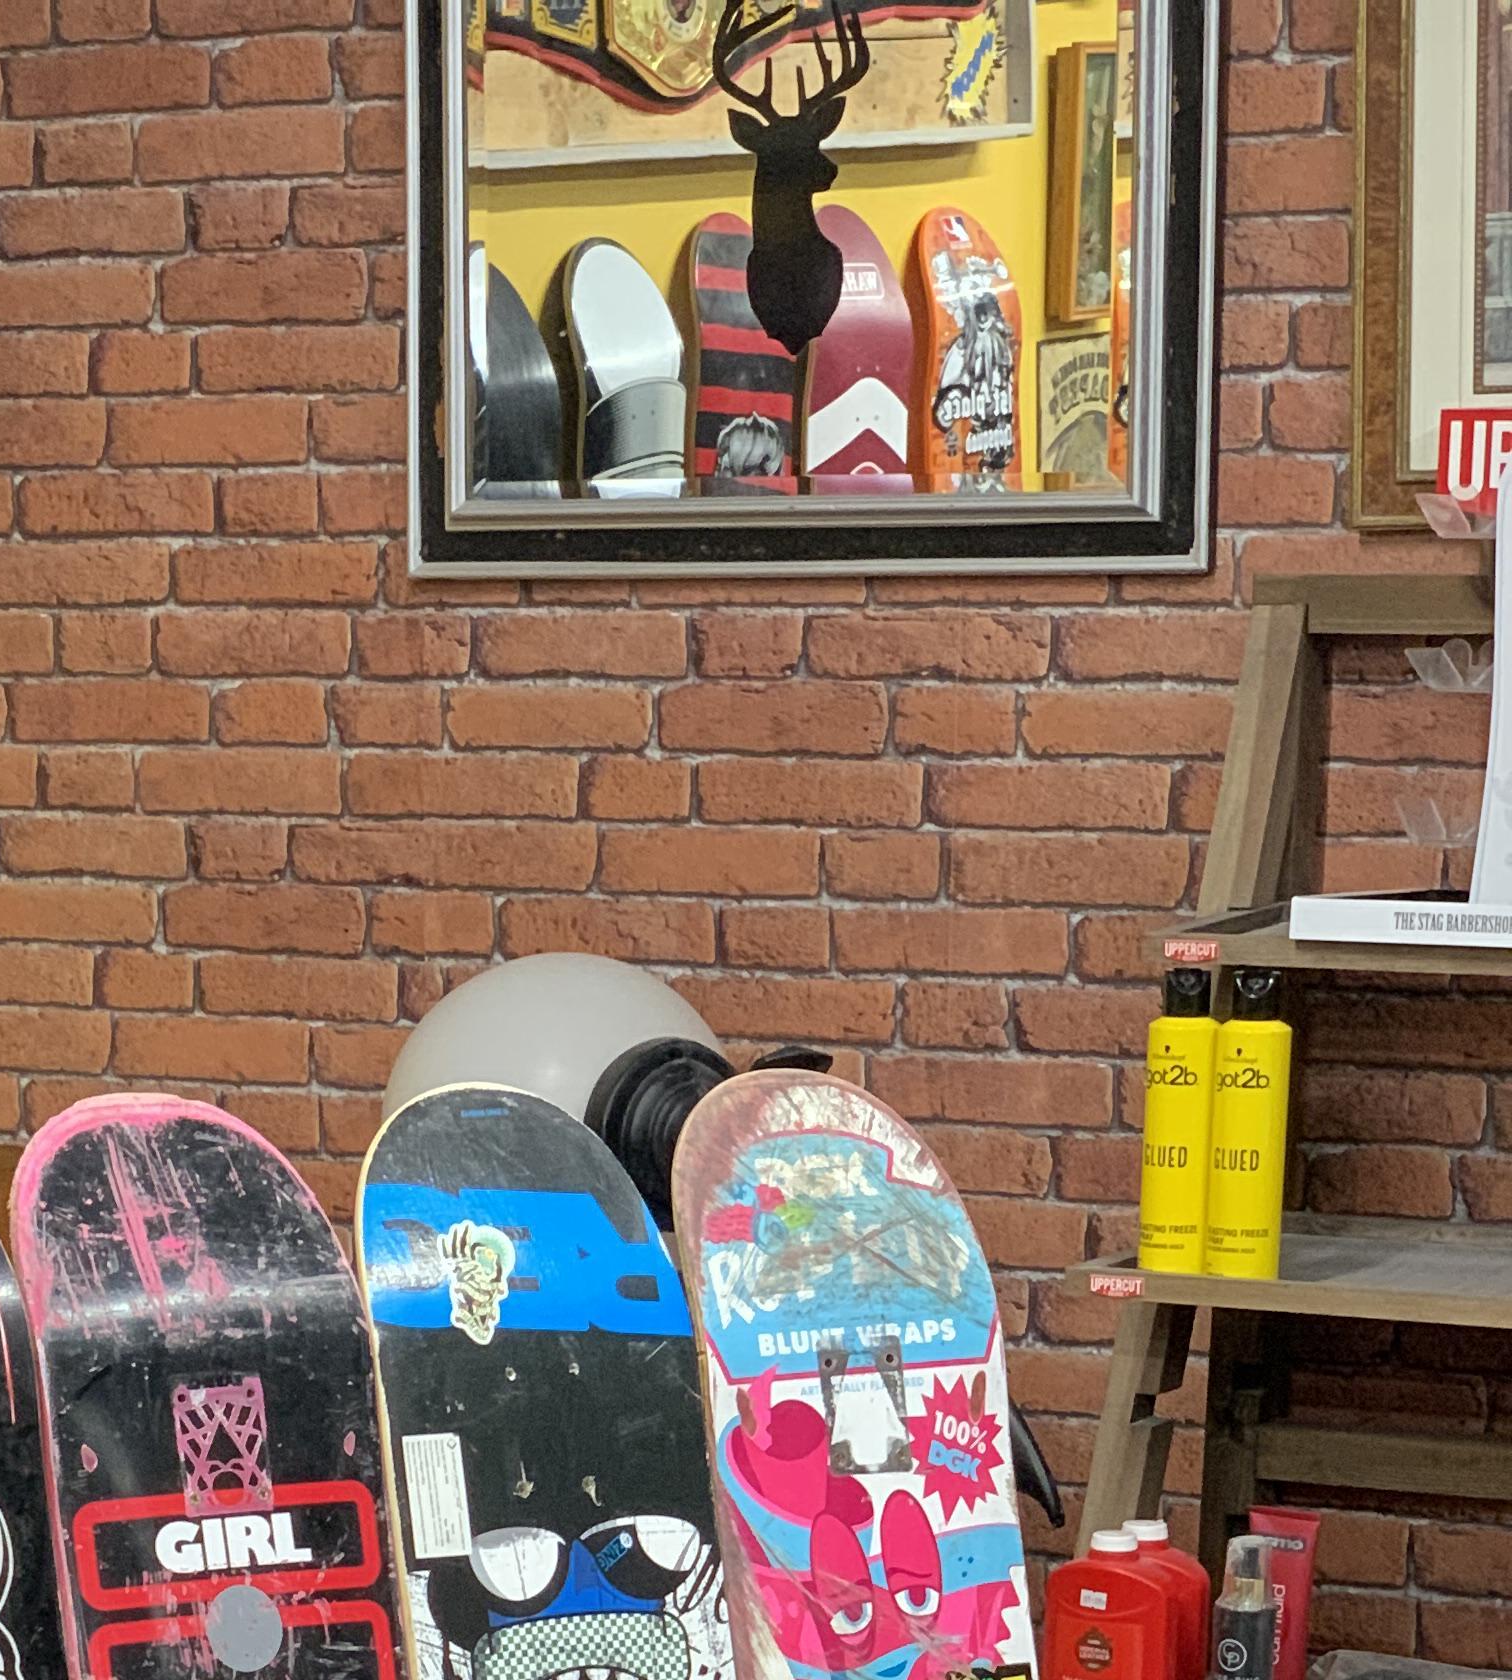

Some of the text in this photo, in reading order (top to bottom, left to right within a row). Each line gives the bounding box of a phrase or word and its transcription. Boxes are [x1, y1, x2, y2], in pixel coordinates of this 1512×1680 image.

[1394, 912, 1417, 931] THE
[1418, 913, 1444, 932] STAG
[1164, 941, 1217, 958] UPPERCUT
[1216, 1067, 1270, 1091] got2b
[1145, 1144, 1188, 1168] GLUED
[1214, 1147, 1260, 1171] GLUED
[1090, 1277, 1142, 1296] UPPERCUT
[758, 1318, 957, 1357] BLUNT WRAPS
[933, 1410, 987, 1454] 100%
[928, 1439, 982, 1482] DGK
[155, 1512, 313, 1574] GIRL
